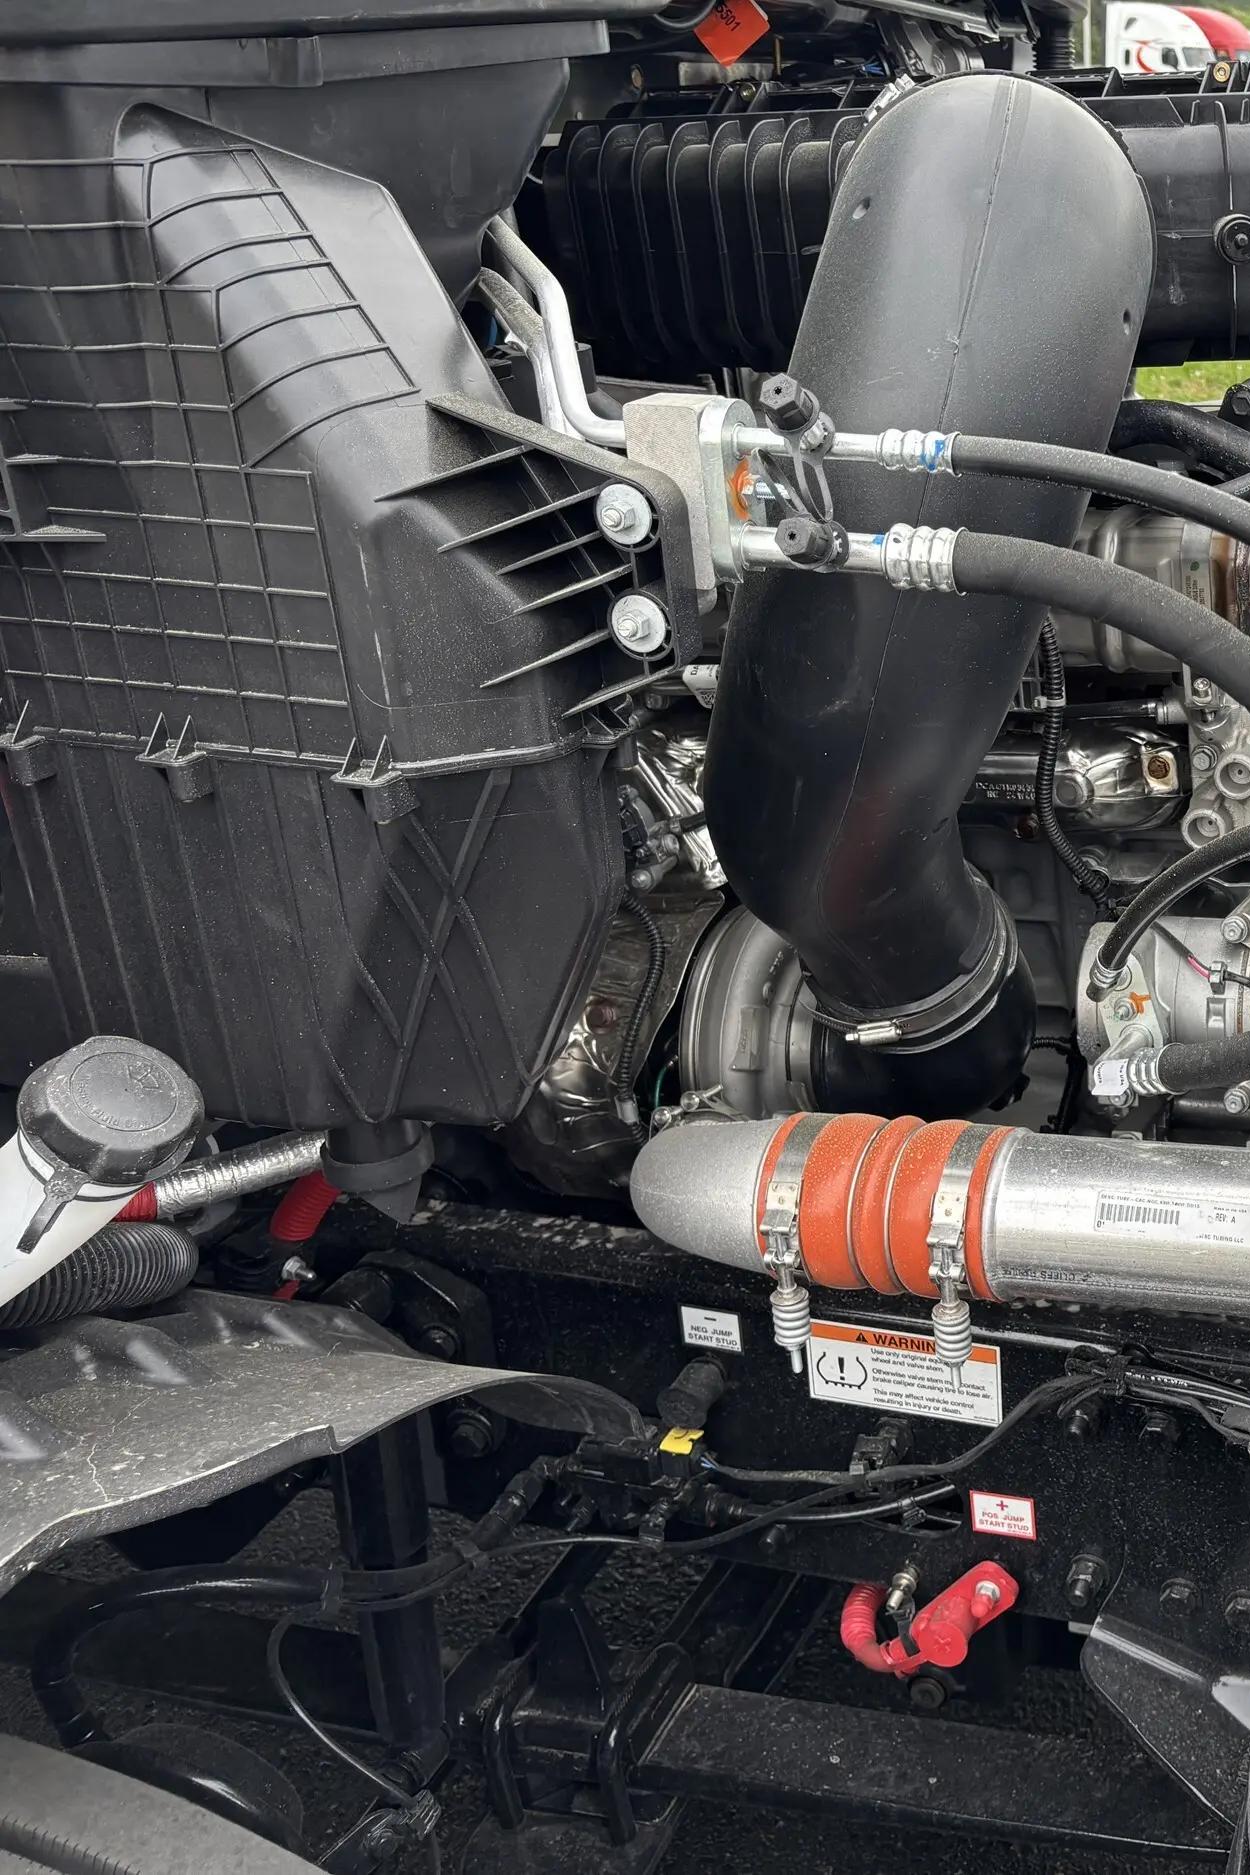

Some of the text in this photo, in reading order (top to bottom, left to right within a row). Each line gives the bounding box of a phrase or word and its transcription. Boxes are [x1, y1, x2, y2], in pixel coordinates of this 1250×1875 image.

[688, 1333, 737, 1346] START STUD
[711, 1329, 732, 1337] JUMP
[873, 1333, 936, 1354] WARNIN
[870, 1347, 885, 1356] Use
[886, 1350, 900, 1359] only
[901, 1352, 927, 1362] original
[871, 1356, 891, 1364] wheel
[892, 1359, 905, 1367] and
[906, 1361, 925, 1369] valve
[872, 1368, 906, 1379] Otherwise
[908, 1373, 925, 1381] valve
[926, 1376, 943, 1384] stem
[872, 1376, 891, 1385] brake
[893, 1378, 915, 1389] caliper
[917, 1383, 944, 1394] causing
[966, 1389, 981, 1397] lose
[873, 1388, 974, 1409] This may affect vehicle control
[874, 1397, 903, 1407] resulting
[913, 1400, 932, 1411] injury
[942, 1404, 962, 1415] death.
[979, 1519, 1029, 1531] START STUD
